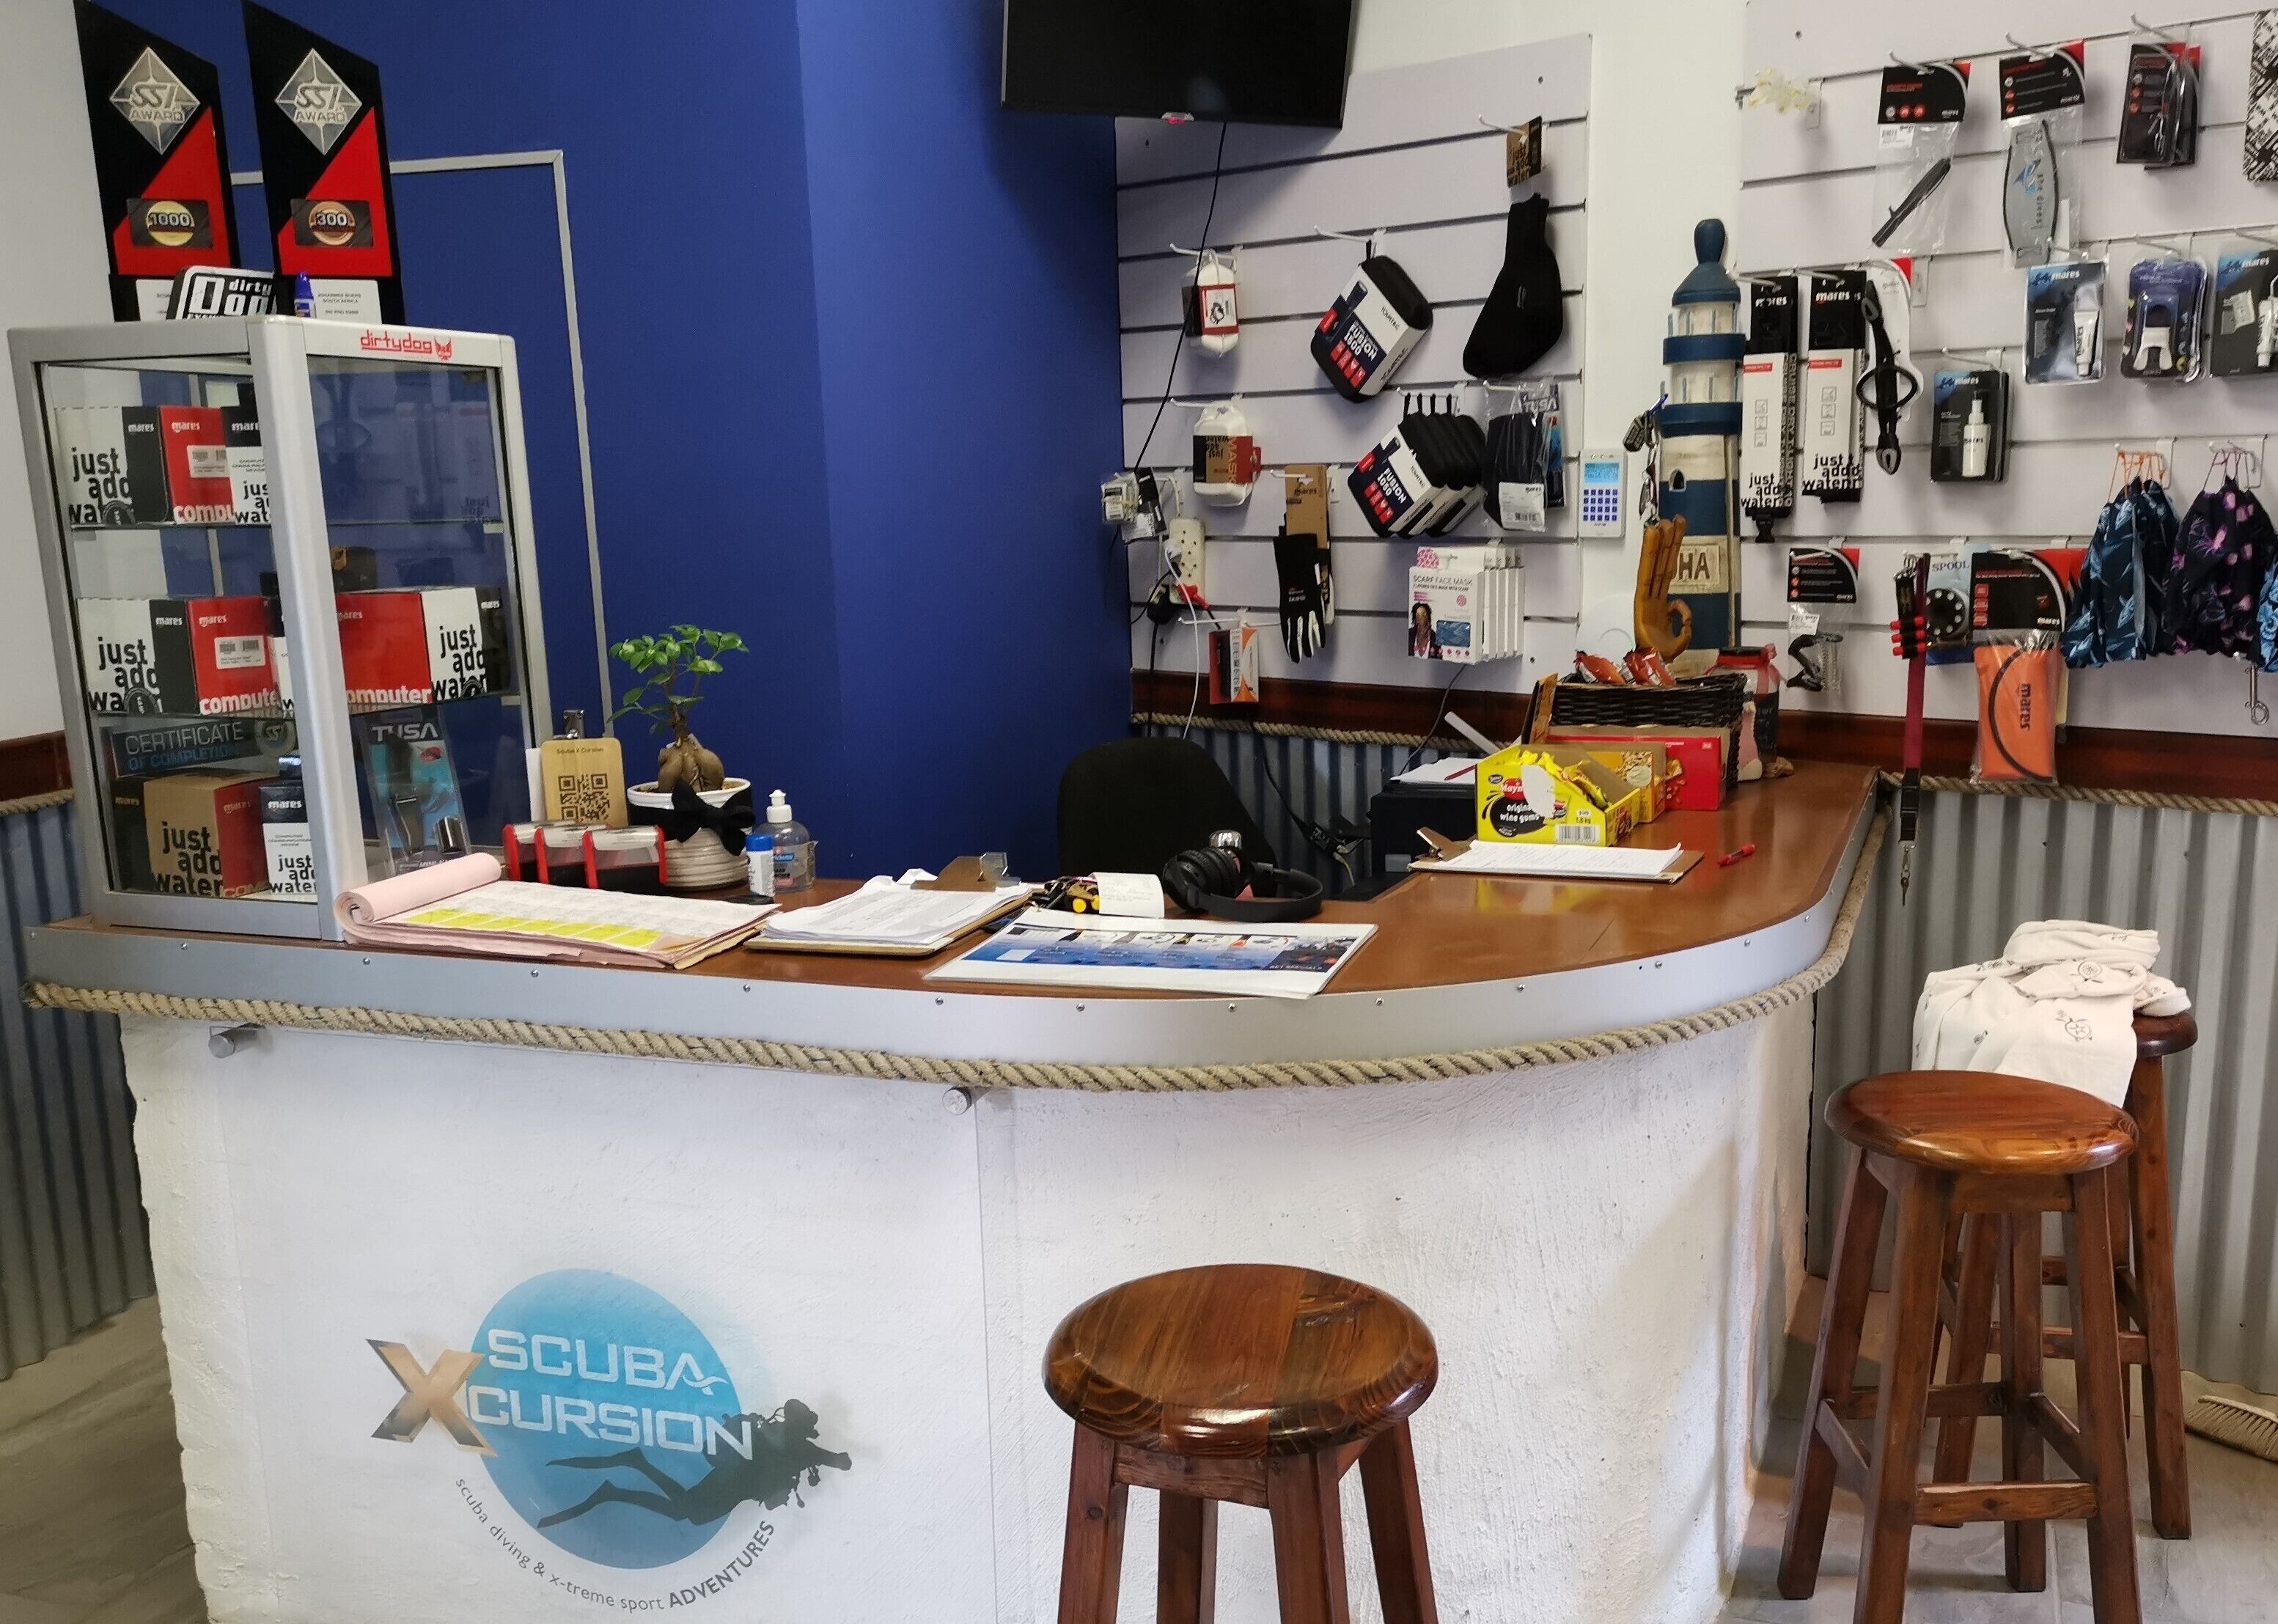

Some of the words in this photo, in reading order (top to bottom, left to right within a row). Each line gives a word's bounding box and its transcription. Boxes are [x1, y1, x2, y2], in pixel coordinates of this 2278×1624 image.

[131, 84, 177, 110] SSI
[295, 84, 342, 110] SSI
[131, 109, 185, 122] AWARD
[295, 109, 348, 122] AWARD
[149, 212, 190, 227] 1000
[315, 213, 347, 227] 300
[2051, 270, 2080, 280] mares
[229, 278, 272, 295] dirty
[1815, 290, 1851, 303] mares
[360, 329, 432, 353] dirtydog
[1524, 398, 1559, 414] TUSA
[128, 422, 155, 433] mares
[171, 421, 201, 433] mares
[231, 422, 259, 432] mar
[70, 446, 121, 482] just
[1227, 437, 1238, 484] MASK
[1813, 453, 1843, 470] just
[1384, 467, 1407, 504] FUSION
[1749, 472, 1774, 488] just
[243, 480, 268, 500] jus
[235, 506, 271, 523] wat
[1932, 559, 1971, 572] SPOOL
[1413, 575, 1433, 584] SCARF
[1434, 576, 1452, 585] FACE
[155, 616, 183, 627] mares
[198, 614, 227, 628] mares
[438, 623, 477, 659] just
[97, 636, 148, 671] just
[199, 686, 282, 716] compute
[345, 685, 433, 705] omputer
[2019, 683, 2032, 731] mares
[125, 721, 245, 756] CERTIFICATE
[268, 799, 302, 810] mares
[1499, 812, 1518, 822] wine
[161, 820, 212, 854] just
[177, 849, 221, 875] add
[277, 853, 313, 872] just
[155, 871, 224, 898] water
[488, 1328, 729, 1397] SCUBA
[455, 1477, 488, 1524] scuba
[488, 1524, 531, 1570] diving
[532, 1561, 545, 1579] &
[550, 1573, 615, 1608] x-treme
[620, 1597, 664, 1614] sport
[668, 1519, 776, 1609] ADVENTURES
